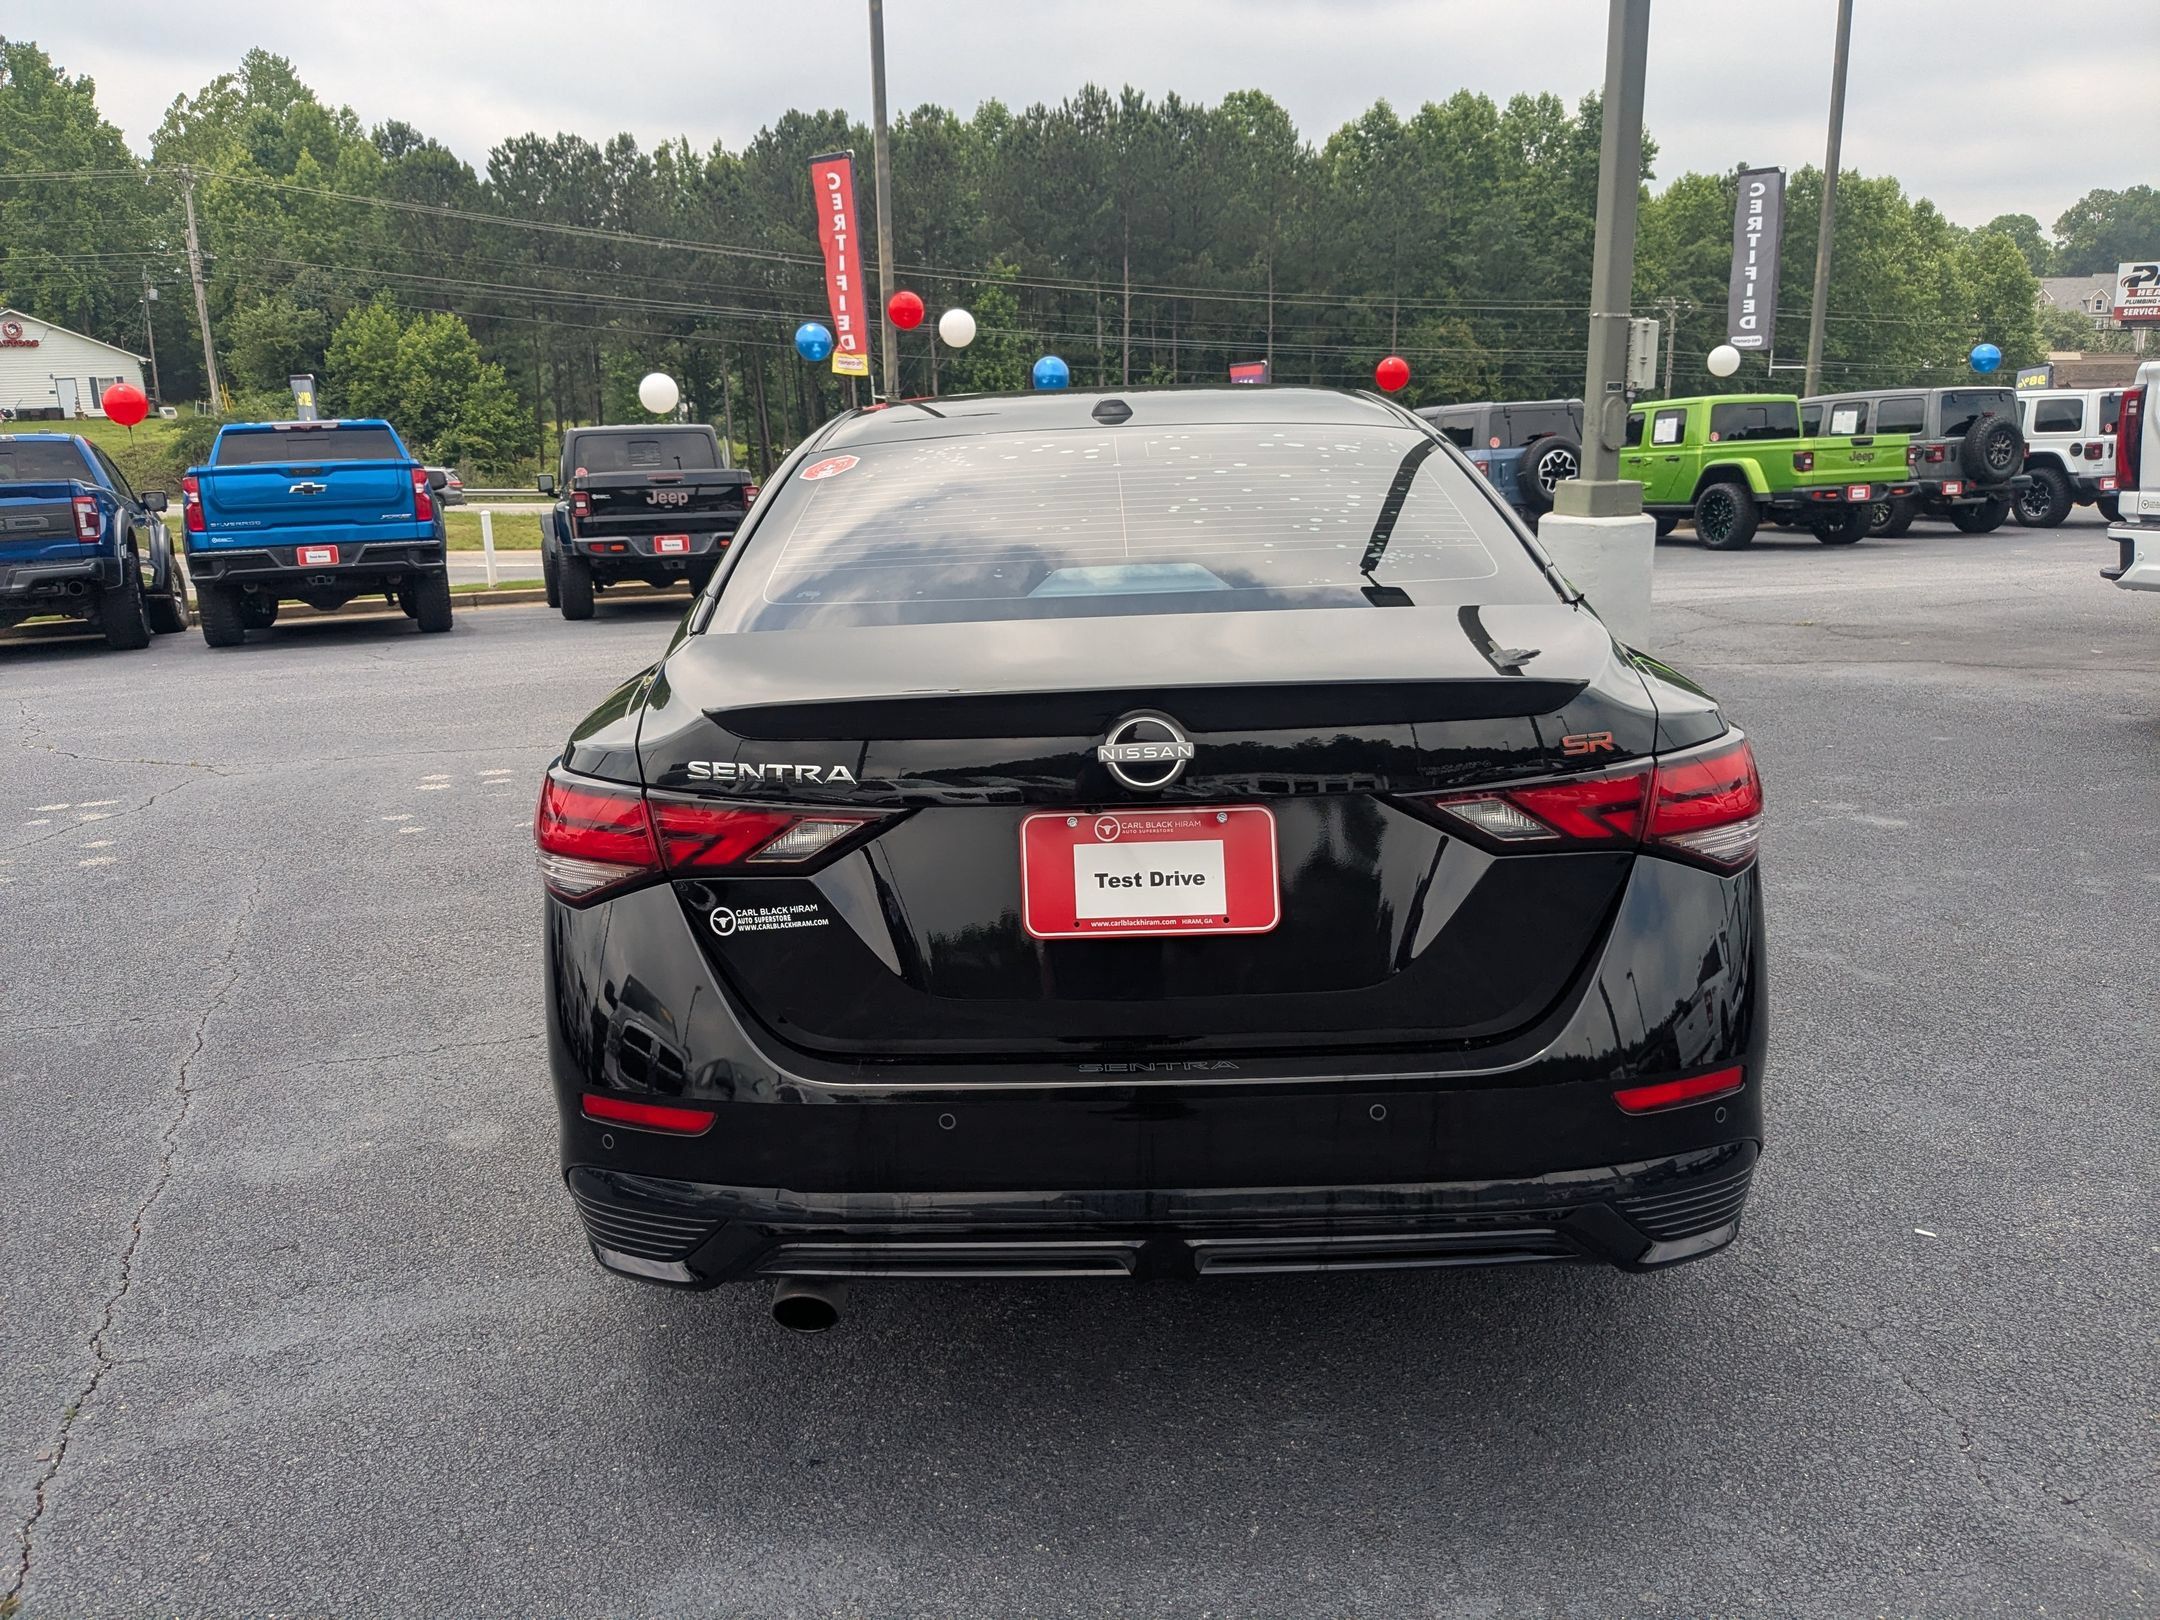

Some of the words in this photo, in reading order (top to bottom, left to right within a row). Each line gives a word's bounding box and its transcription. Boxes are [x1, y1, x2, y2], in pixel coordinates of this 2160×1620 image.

[1849, 450, 1875, 463] Jeep
[646, 490, 688, 506] Jeep
[1562, 731, 1615, 756] SR
[1100, 745, 1193, 760] NISSAN
[687, 761, 857, 784] SENTRA
[1121, 822, 1144, 830] CARL
[1145, 821, 1174, 829] BLACK
[1174, 820, 1202, 828] HIRAM
[1094, 872, 1143, 889] Test
[1149, 870, 1206, 887] Drive
[735, 908, 759, 917] CARL
[760, 906, 789, 916] BLACK
[789, 903, 819, 914] HIRAM
[737, 917, 753, 925] AUTO
[754, 914, 792, 924] SUPERSTORE
[737, 918, 829, 932] WWW.CARLBLACKHIRAM.COM
[1090, 919, 1177, 928] www.carlblackhiram.com
[1078, 1060, 1240, 1073] SENTRA
